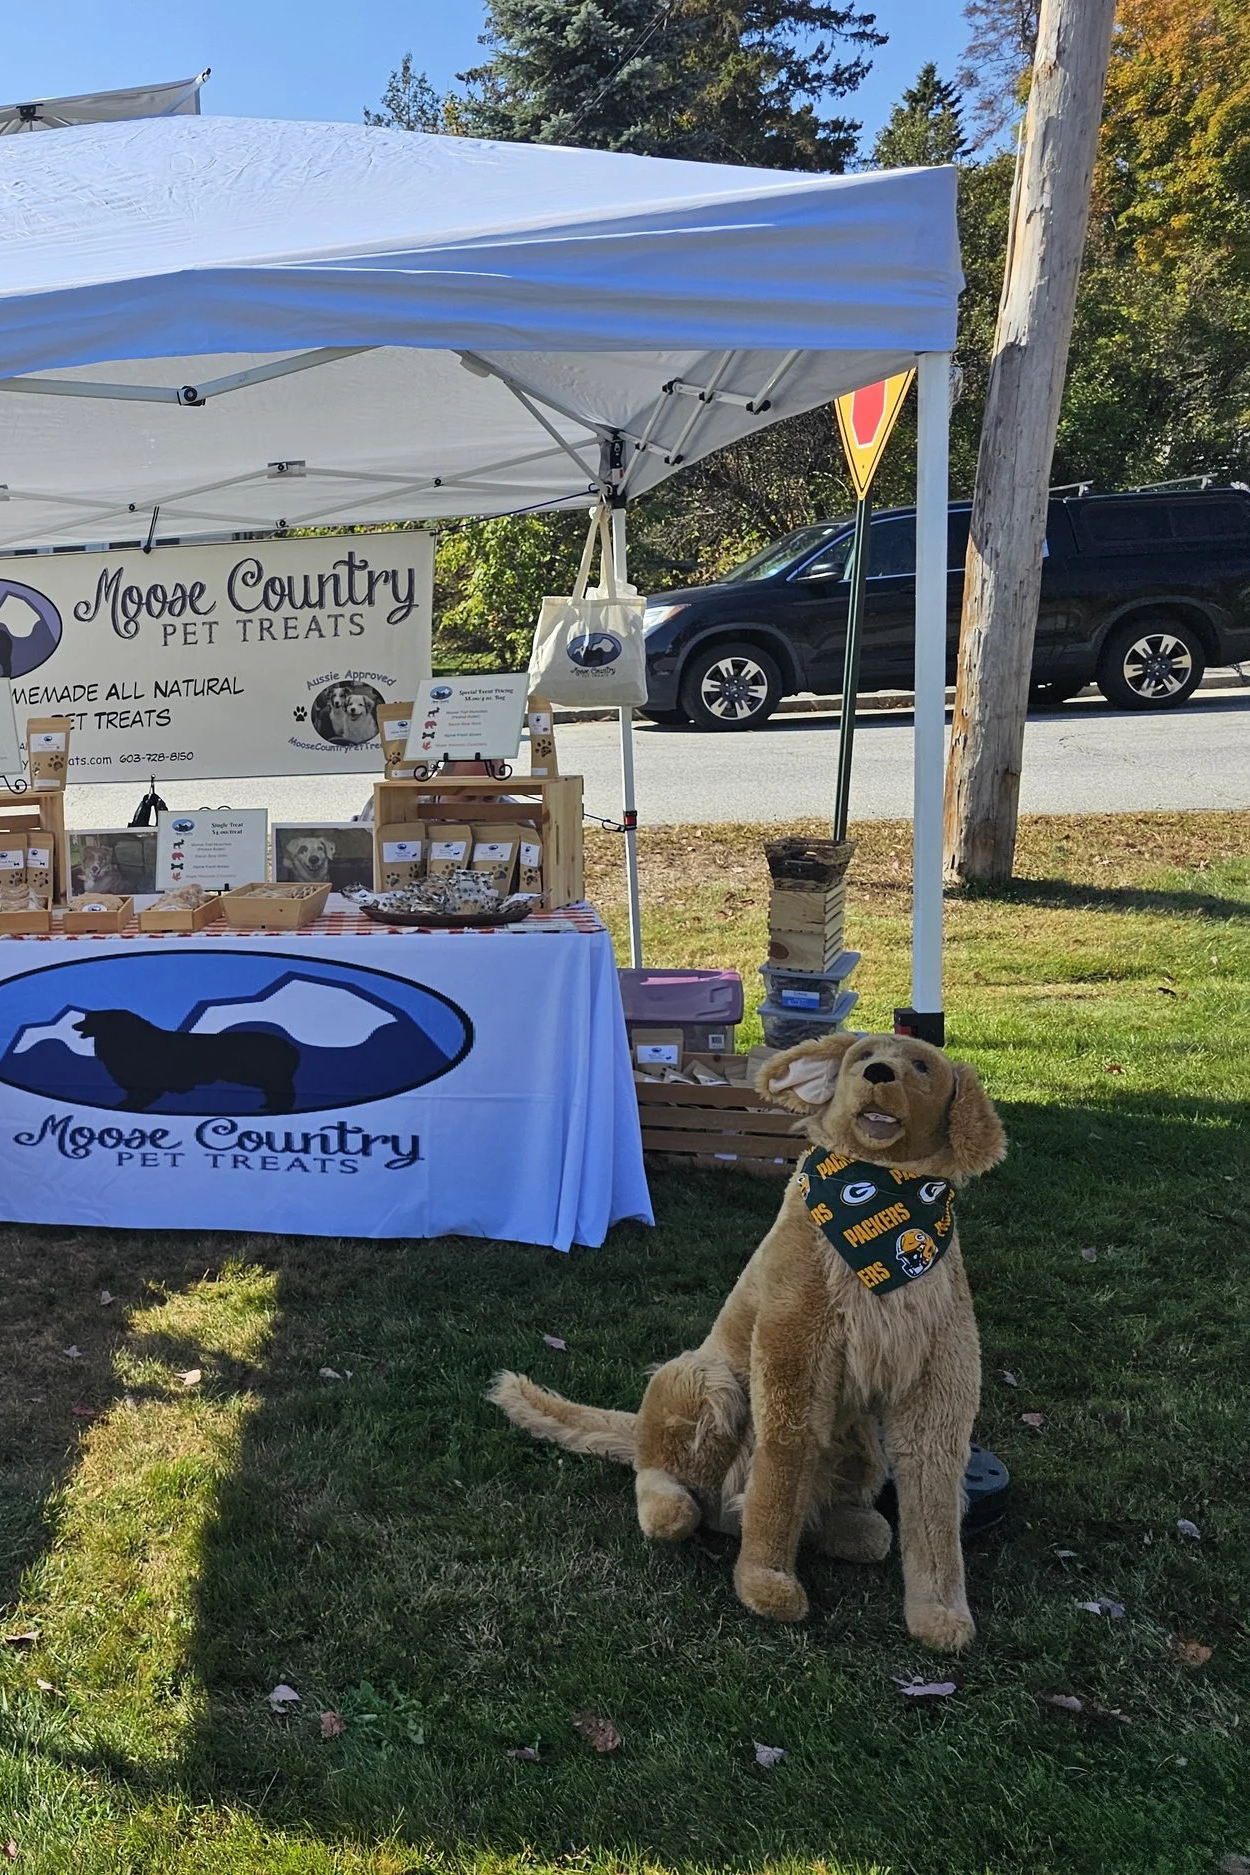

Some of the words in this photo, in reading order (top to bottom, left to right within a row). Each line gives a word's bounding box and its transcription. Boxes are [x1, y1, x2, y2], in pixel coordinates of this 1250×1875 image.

[73, 565, 217, 640] Moose
[227, 551, 420, 626] Country
[162, 620, 220, 647] PET
[236, 612, 366, 643] TREATS
[11, 683, 99, 705] MEMADE
[105, 681, 145, 701] ALL
[153, 676, 245, 699] NATURAL
[306, 671, 340, 691] Aussie
[344, 669, 398, 688] Approved
[94, 708, 172, 730] TREATS
[119, 751, 194, 764] 603-728-8150
[13, 1113, 184, 1160] Moose
[195, 1116, 425, 1171] Country
[116, 1150, 186, 1168] PET
[204, 1152, 359, 1175] TREATS
[842, 1201, 912, 1249] PACKERS
[856, 1260, 891, 1290] ERS
